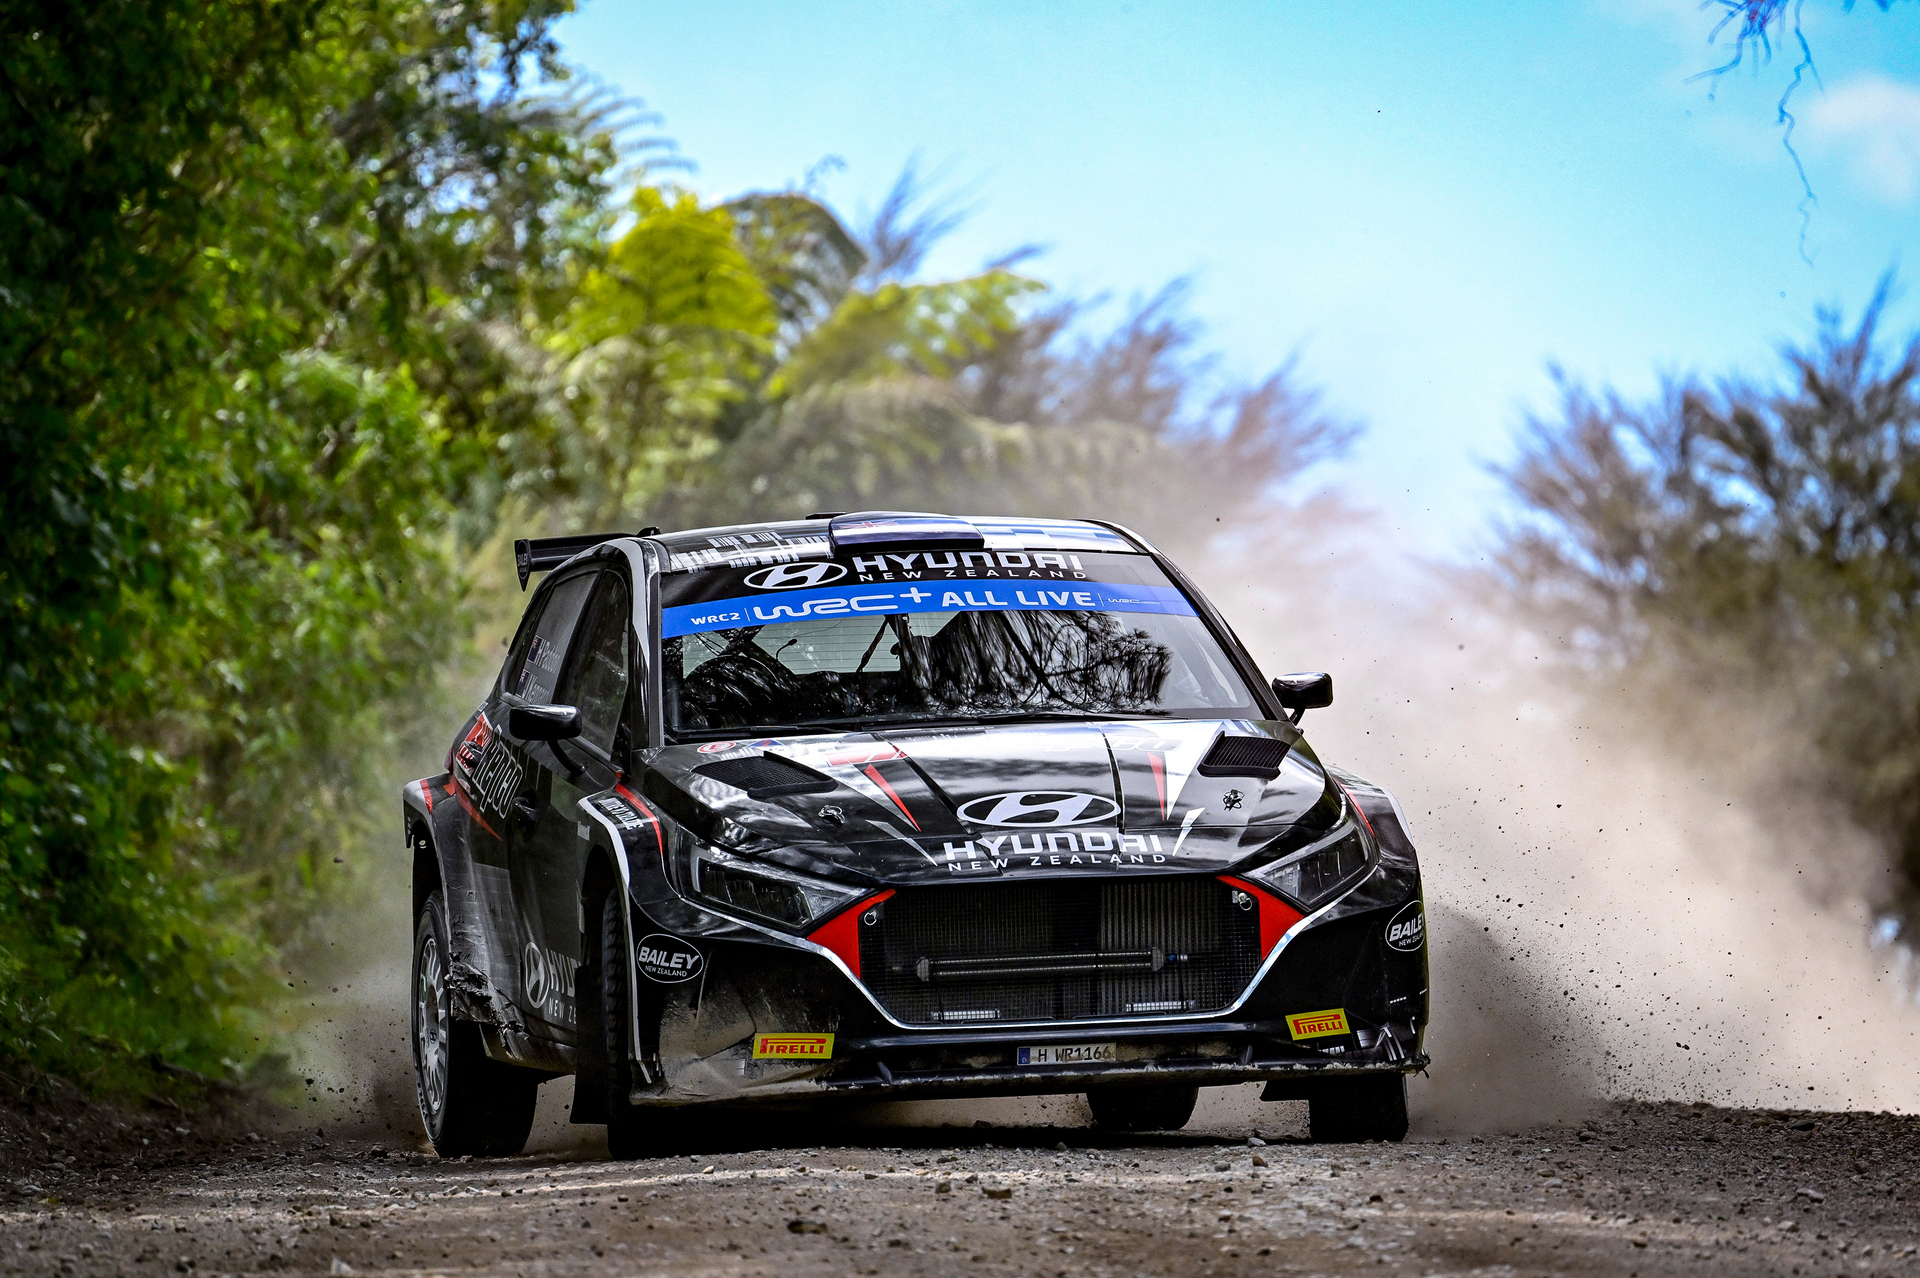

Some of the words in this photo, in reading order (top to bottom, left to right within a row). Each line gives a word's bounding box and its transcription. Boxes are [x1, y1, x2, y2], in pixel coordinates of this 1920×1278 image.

[852, 551, 1084, 573] HYUNDAI
[860, 570, 922, 582] NEW
[945, 568, 1087, 579] ZEALAND
[690, 612, 741, 626] WRC2
[942, 591, 1008, 607] ALL
[1018, 591, 1096, 607] LIVE
[943, 832, 1164, 861] HYUNDAI
[948, 858, 1008, 872] NEW
[1030, 853, 1166, 866] ZEALAND
[1389, 912, 1425, 942] BAILE
[639, 946, 699, 970] BAILEY
[644, 965, 657, 973] NEW
[657, 967, 688, 977] ZEALAND
[1292, 1014, 1343, 1035] PIRELLI
[759, 1037, 827, 1054] PIRELLI
[1038, 1048, 1048, 1063] H
